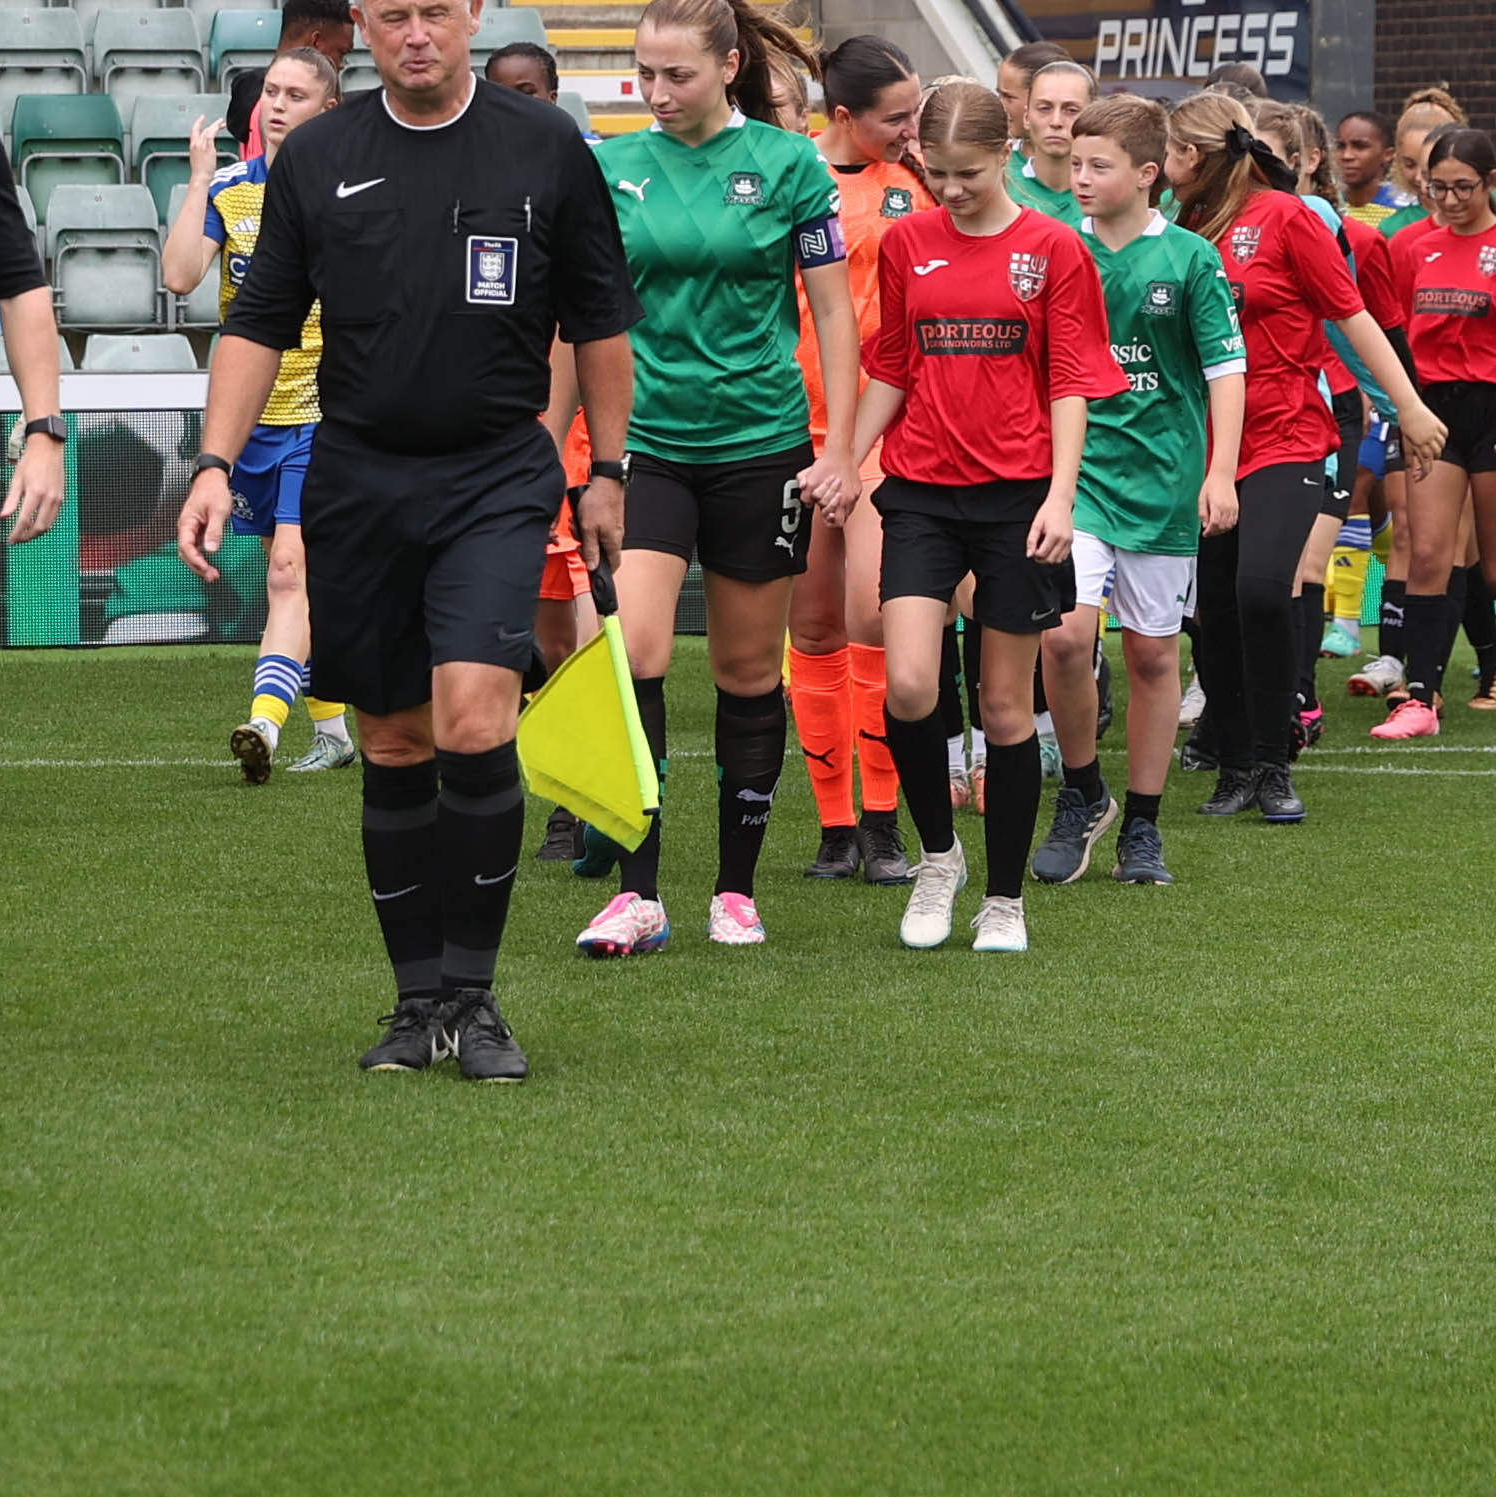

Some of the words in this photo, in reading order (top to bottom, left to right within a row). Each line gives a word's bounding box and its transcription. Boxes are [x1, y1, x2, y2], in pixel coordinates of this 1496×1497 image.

[1095, 12, 1299, 80] PRINCESS
[473, 288, 509, 298] OFFICIAL
[477, 281, 506, 290] MATCH
[920, 323, 1023, 351] PORTEOUS
[781, 478, 802, 535] 5
